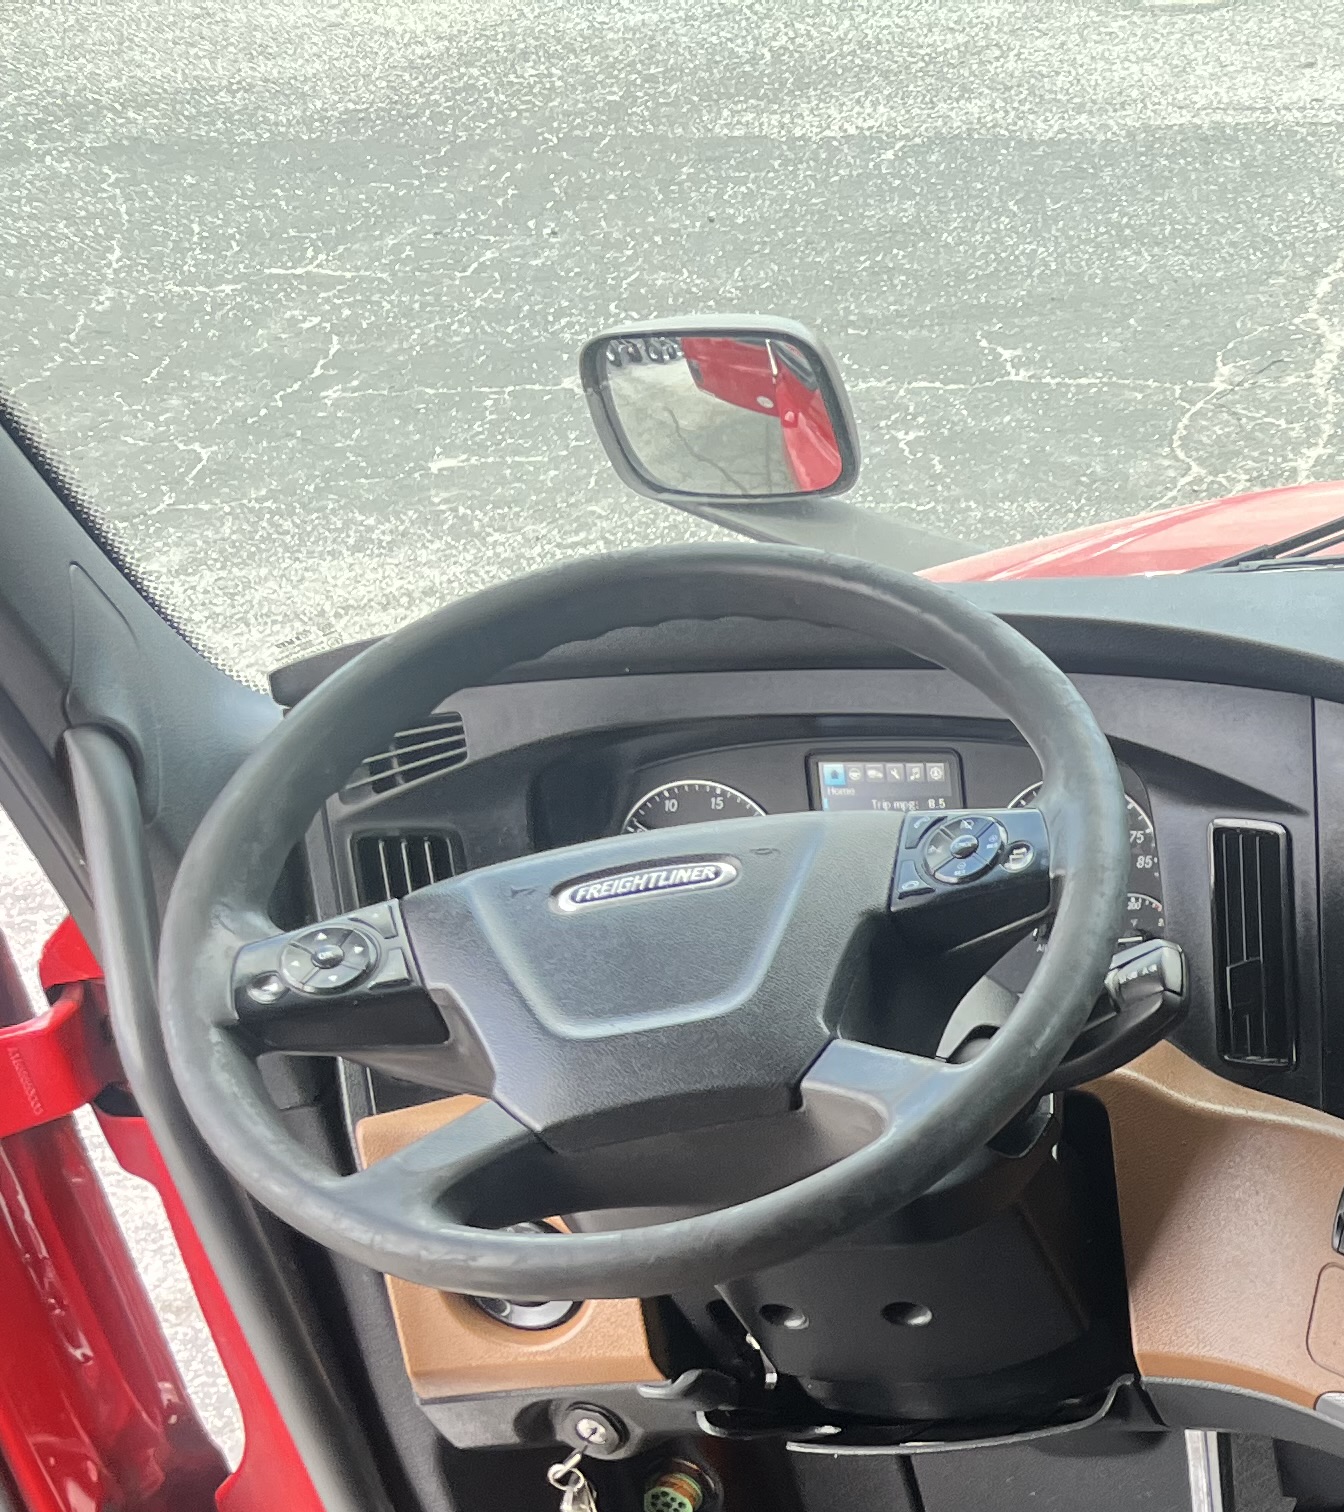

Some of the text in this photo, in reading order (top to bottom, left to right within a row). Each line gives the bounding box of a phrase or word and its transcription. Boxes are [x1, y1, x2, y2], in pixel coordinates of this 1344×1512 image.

[827, 787, 856, 796] Home
[664, 799, 678, 812] 10
[710, 797, 724, 810] 15
[871, 799, 892, 811] Trip
[893, 801, 920, 811] mpg:
[1129, 830, 1145, 844] 75
[1136, 855, 1153, 868] 85
[575, 865, 717, 903] FREIGHTLINER
